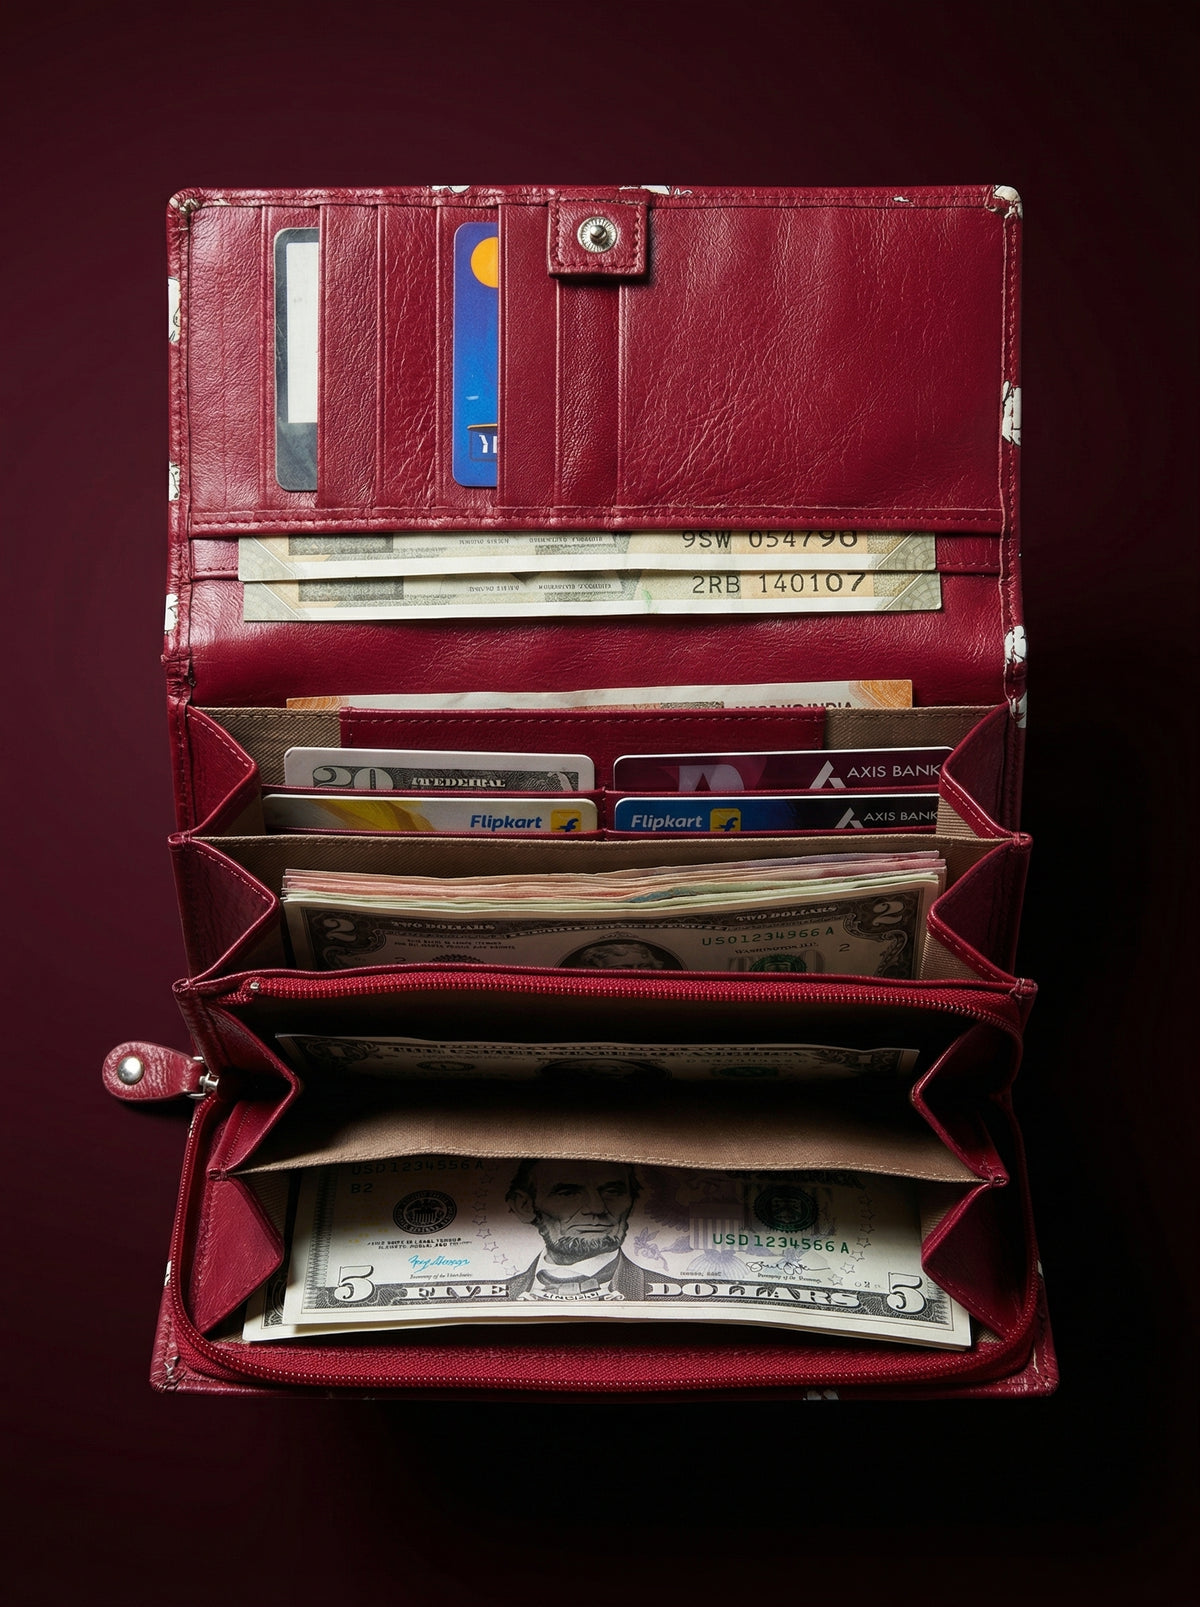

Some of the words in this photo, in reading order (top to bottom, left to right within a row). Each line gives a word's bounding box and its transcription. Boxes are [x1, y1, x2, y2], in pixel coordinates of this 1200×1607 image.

[682, 530, 732, 548] 9SW
[692, 575, 740, 594] 2RB
[759, 572, 866, 593] 140107
[847, 766, 887, 778] AXIS
[893, 764, 941, 777] BANK
[470, 814, 542, 832] Flipkart
[631, 814, 702, 831] Flipkart
[863, 811, 898, 822] AXIS
[900, 810, 938, 821] BANK
[872, 901, 904, 926] 2
[323, 918, 358, 941] 2
[839, 943, 850, 952] 2
[351, 1183, 373, 1194] B2
[334, 1264, 376, 1302] 5
[401, 1284, 510, 1301] FIVE
[647, 1282, 861, 1308] DOLLARS
[886, 1271, 927, 1314] 5
